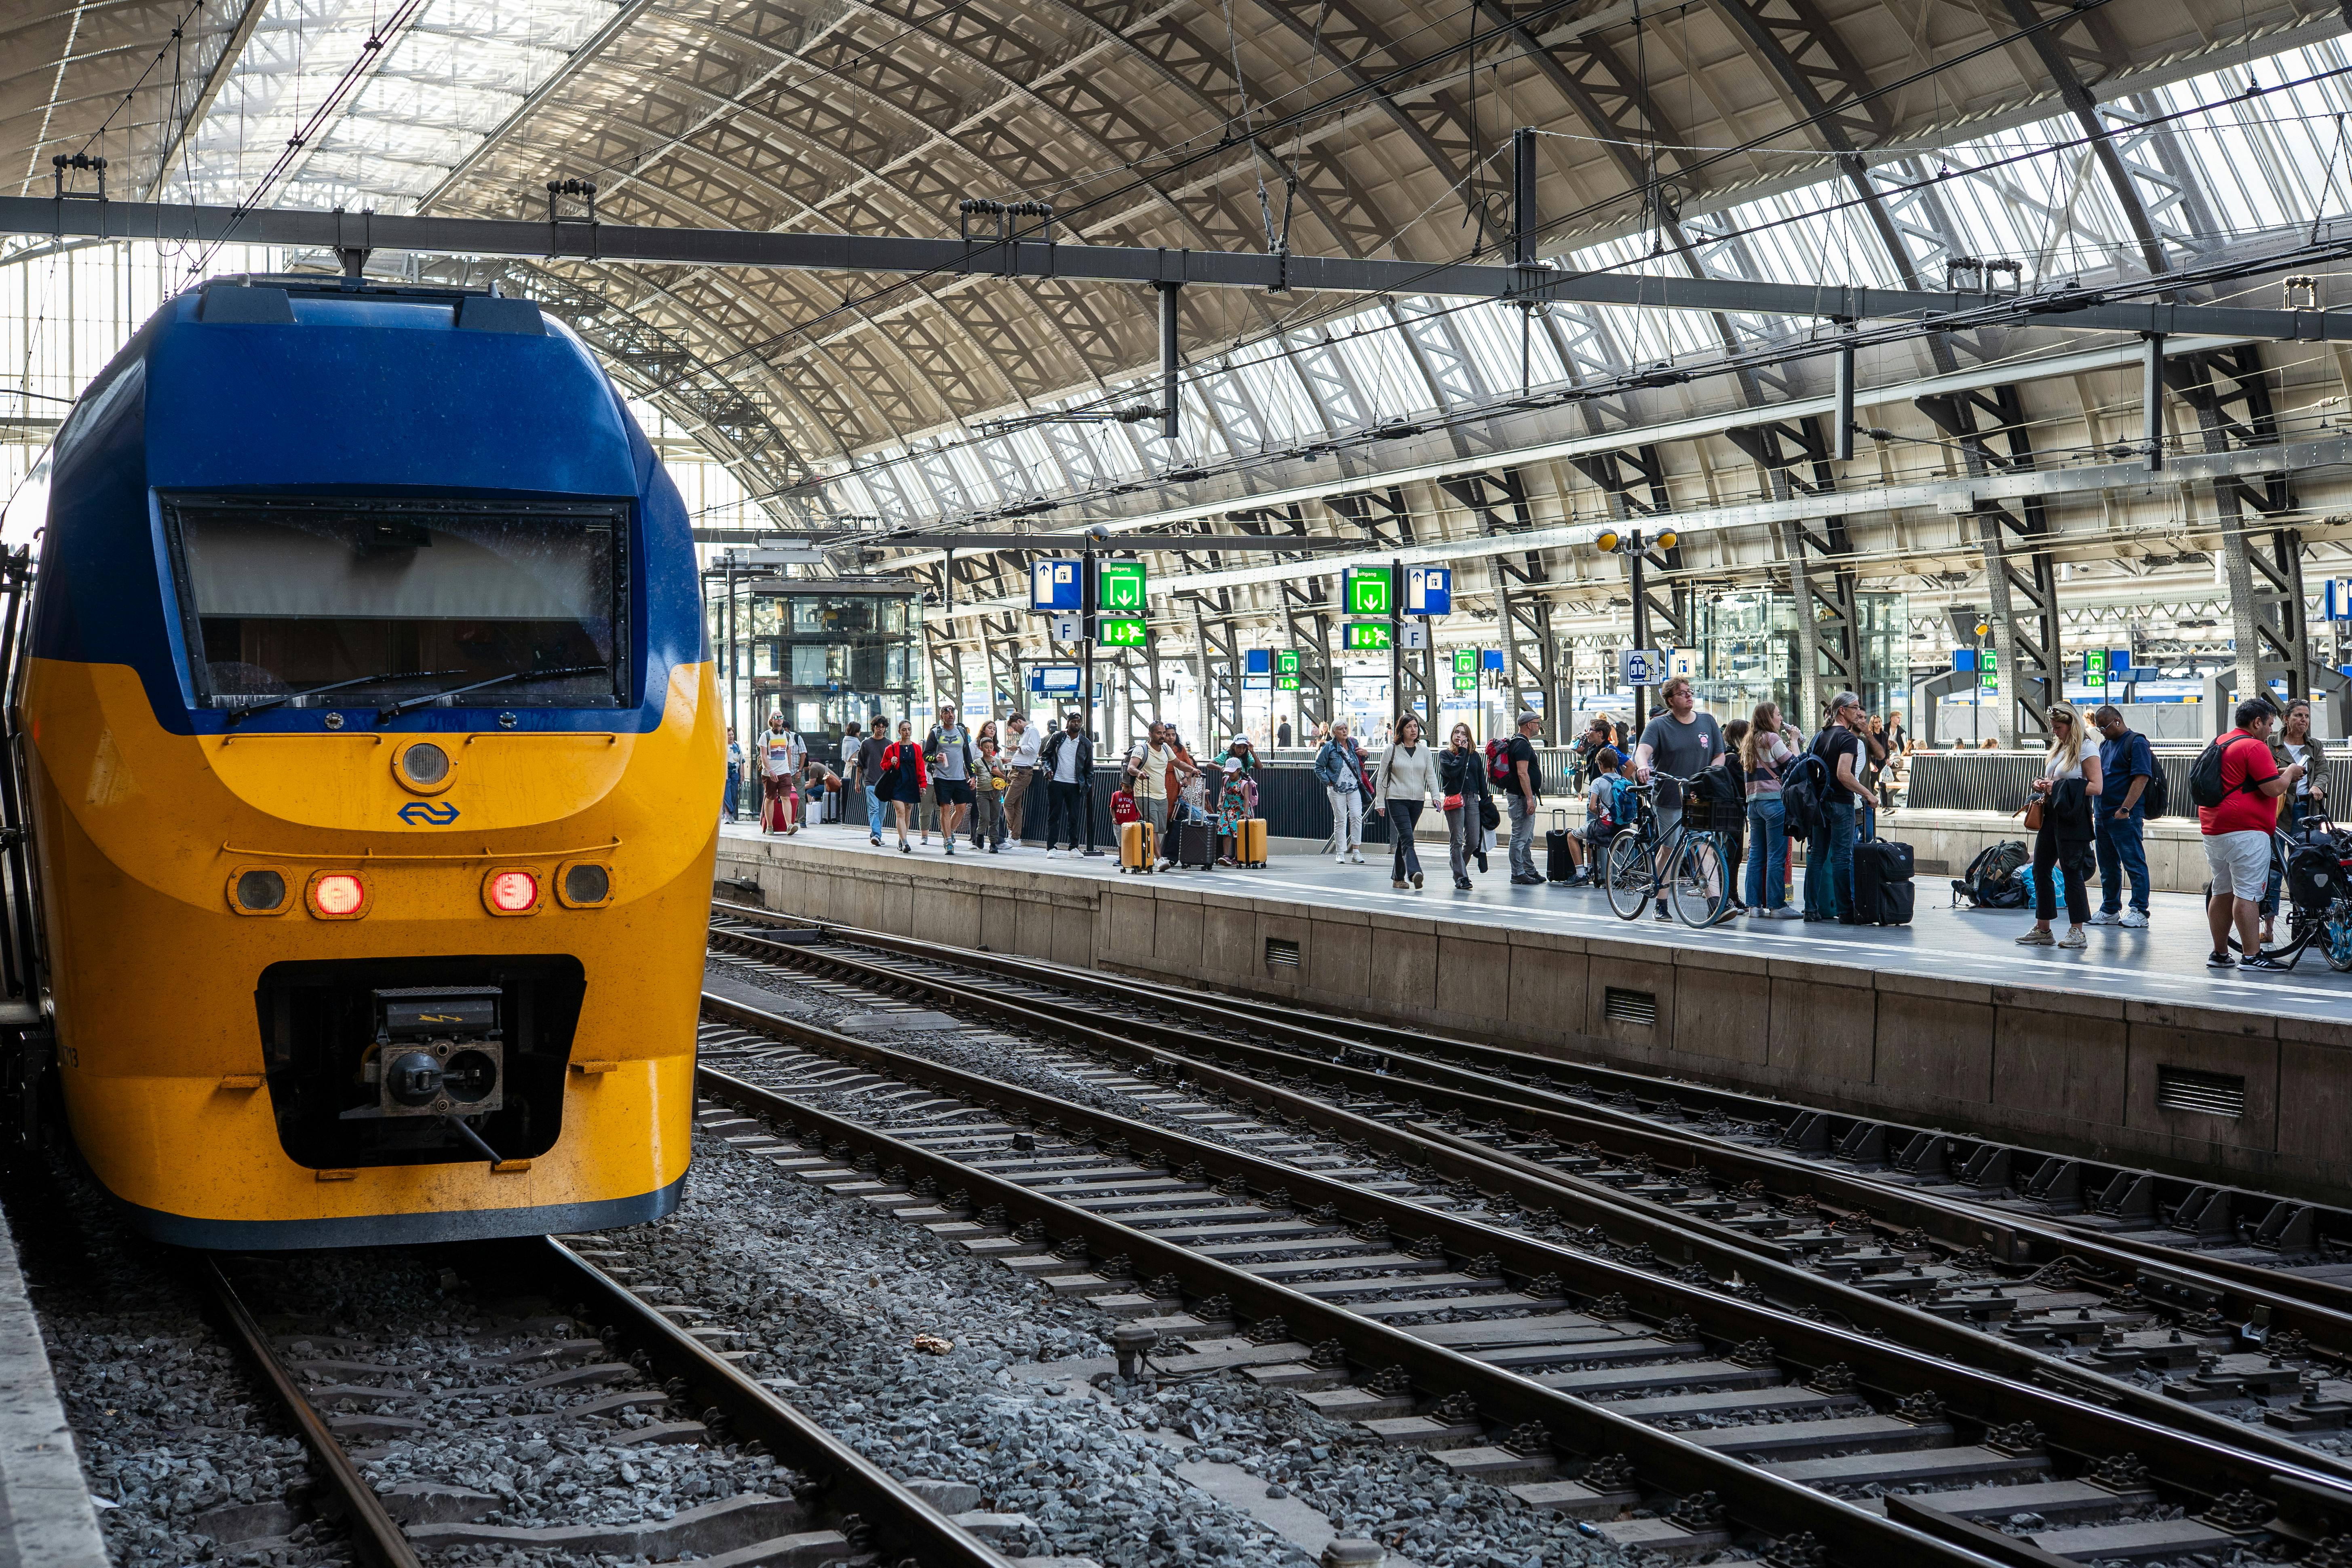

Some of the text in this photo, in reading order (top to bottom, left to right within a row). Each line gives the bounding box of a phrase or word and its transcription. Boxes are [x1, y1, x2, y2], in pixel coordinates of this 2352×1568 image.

[1062, 624, 1071, 638] F
[1411, 632, 1419, 646] F
[1012, 673, 1019, 682] V
